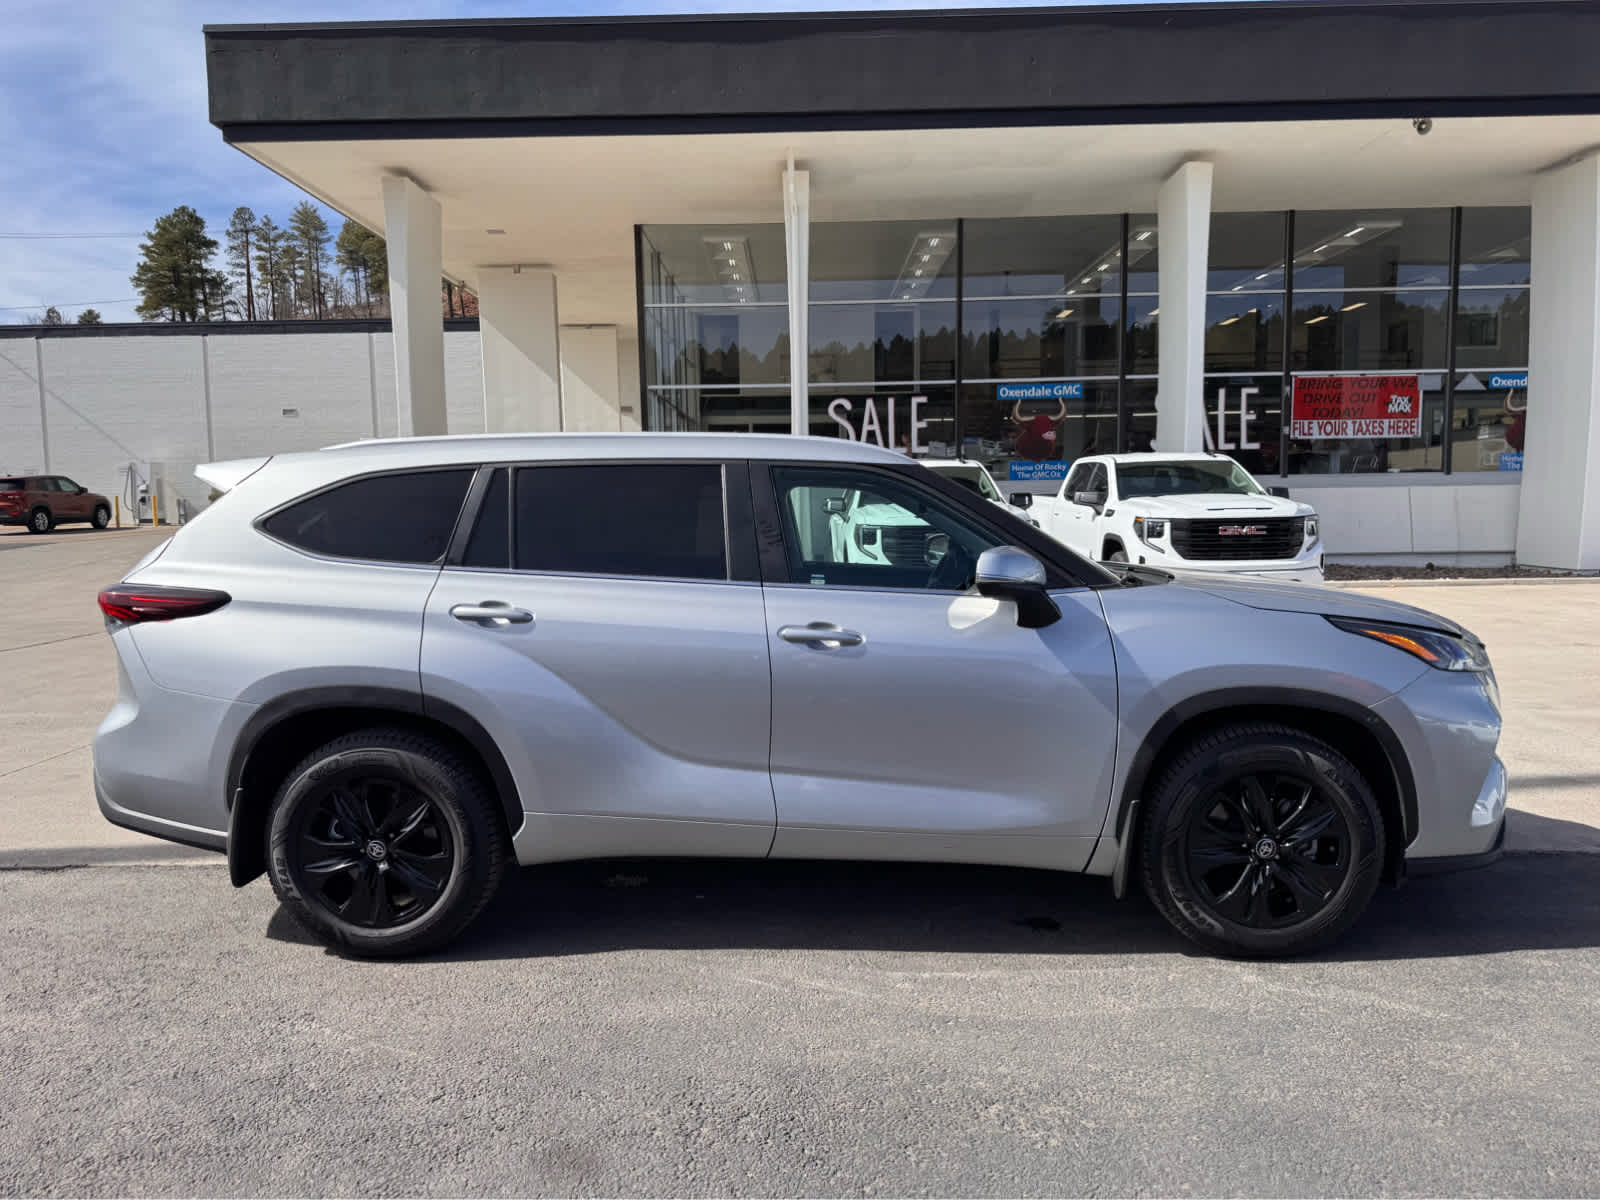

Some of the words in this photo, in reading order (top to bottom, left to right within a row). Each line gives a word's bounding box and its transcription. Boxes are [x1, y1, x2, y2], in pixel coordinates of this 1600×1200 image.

[1298, 378, 1344, 390] BRING
[1351, 378, 1389, 389] YOUR
[1393, 377, 1418, 389] W2
[1491, 376, 1528, 386] Oxend
[1000, 386, 1051, 398] Oxendale
[1053, 384, 1081, 396] GMC
[1303, 393, 1344, 405] DRIVE
[1390, 394, 1410, 404] TAX
[1311, 407, 1365, 418] TODAY!
[1387, 402, 1412, 414] MAX
[828, 396, 929, 453] SALE
[1292, 421, 1313, 437] FILE
[1317, 420, 1349, 436] YOUR
[1352, 420, 1385, 436] TAXES
[1388, 420, 1419, 435] HERE!
[1044, 463, 1066, 472] Rocky
[1017, 471, 1031, 479] The
[1218, 525, 1268, 536] GMC
